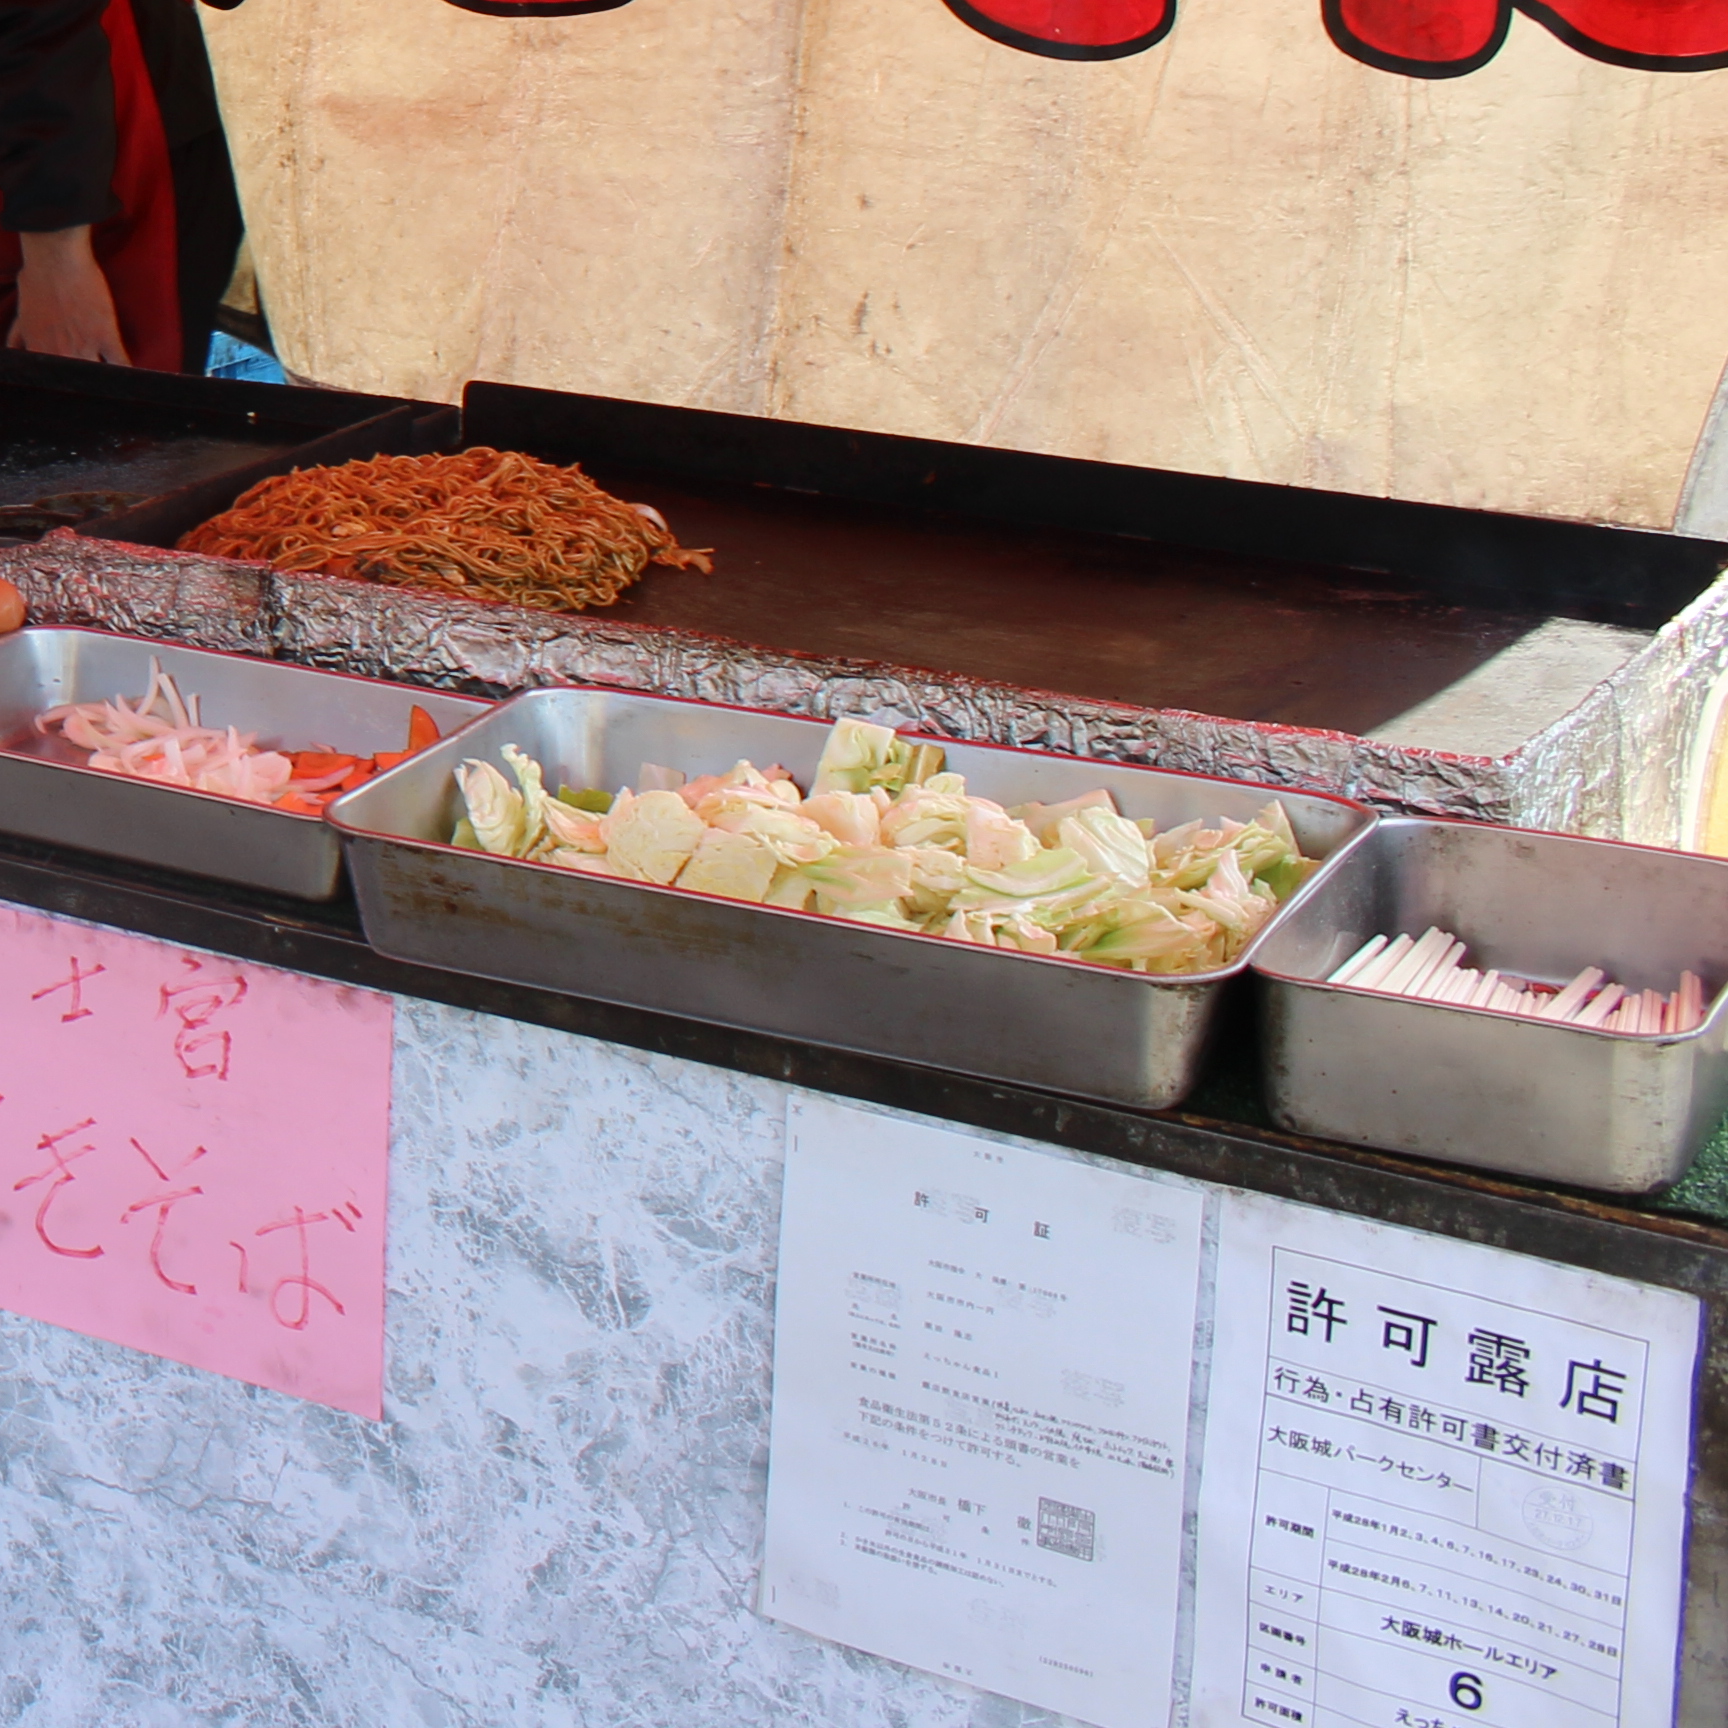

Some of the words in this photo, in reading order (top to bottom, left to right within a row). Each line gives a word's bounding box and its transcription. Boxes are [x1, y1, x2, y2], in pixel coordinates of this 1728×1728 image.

[1285, 1280, 1627, 1424] 許可露店
[1267, 1425, 1474, 1495] 大阪城パークセンター
[1273, 1367, 1630, 1491] 行為・占有許可書交付済書
[1263, 1582, 1305, 1605] エリア
[1380, 1615, 1560, 1681] 大阪城ホールエリア
[1449, 1671, 1483, 1710] 6
